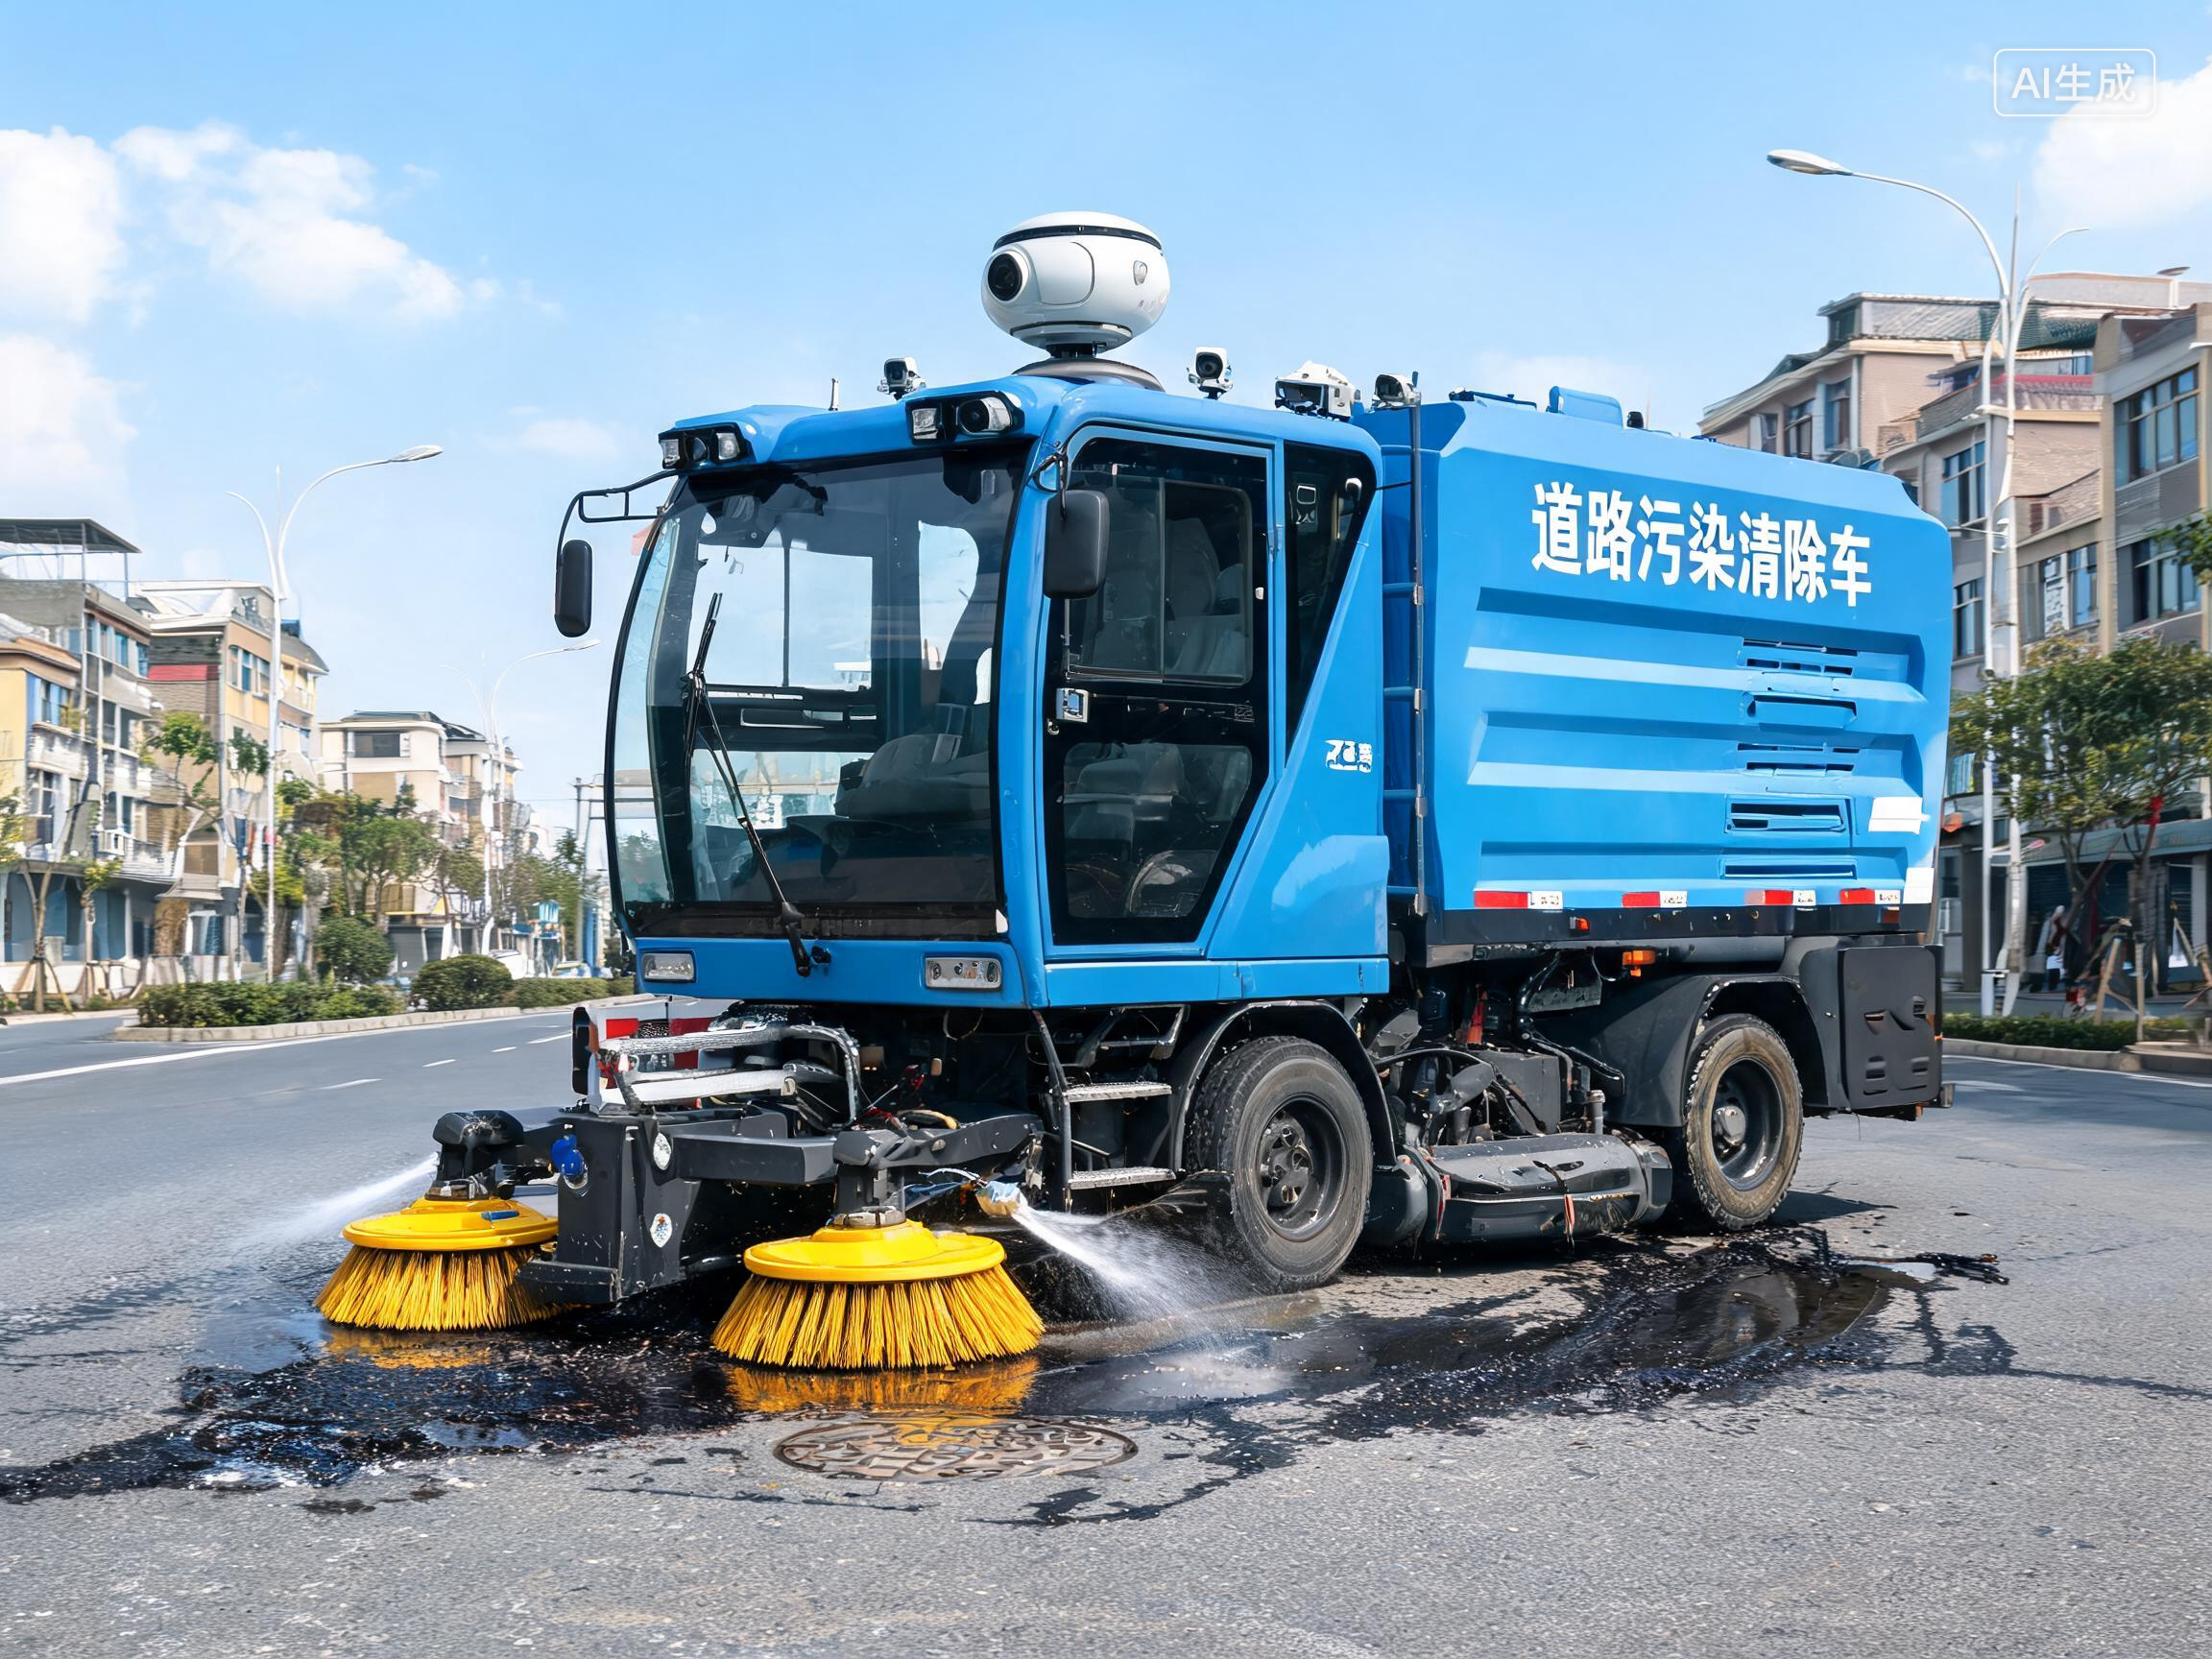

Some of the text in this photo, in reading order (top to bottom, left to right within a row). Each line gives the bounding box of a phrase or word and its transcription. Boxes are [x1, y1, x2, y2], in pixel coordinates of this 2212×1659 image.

[1531, 482, 1872, 607] 道路污染清除车
